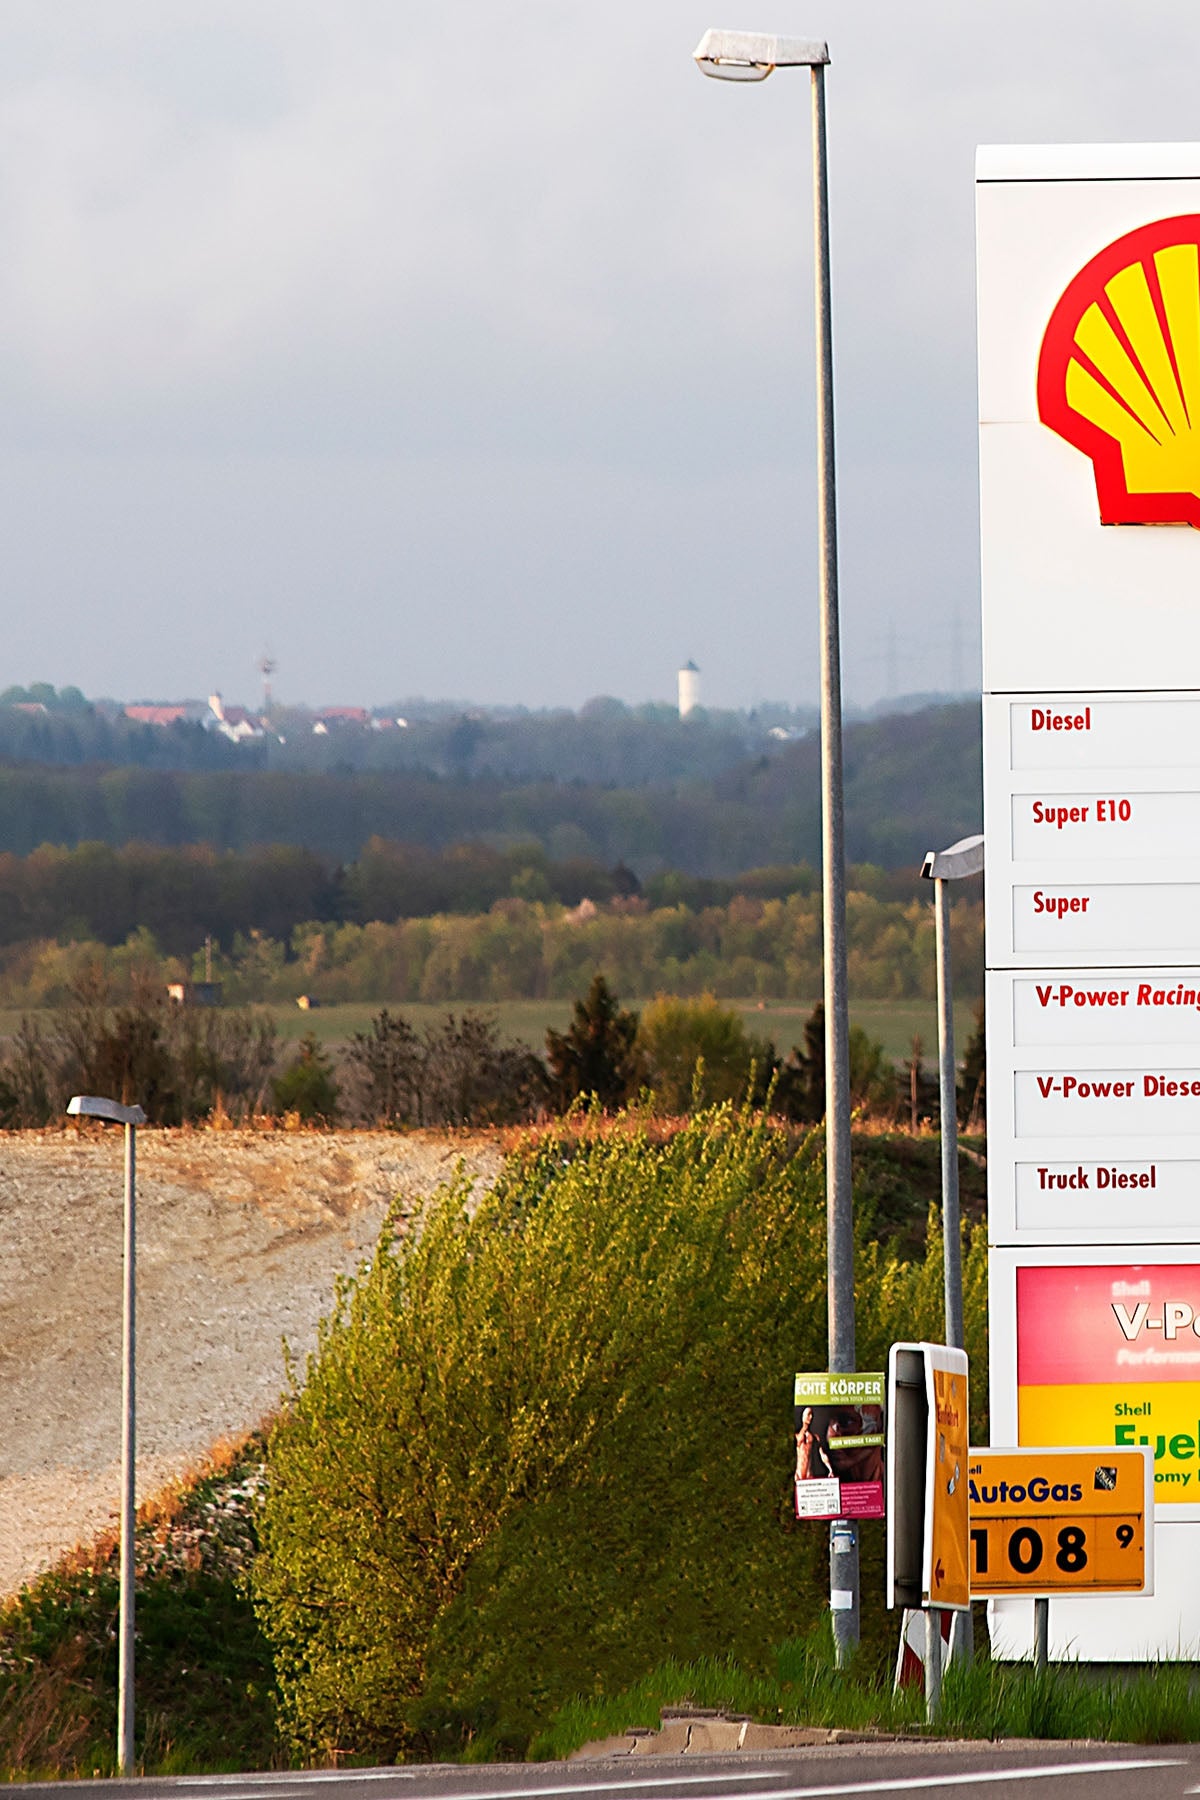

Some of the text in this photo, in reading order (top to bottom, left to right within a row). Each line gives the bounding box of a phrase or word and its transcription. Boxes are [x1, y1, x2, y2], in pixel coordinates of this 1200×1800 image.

[1031, 707, 1091, 731] Diesel
[1032, 799, 1132, 829] Super E10
[1033, 891, 1090, 919] Super
[1036, 984, 1130, 1008] V-Power
[1036, 1075, 1134, 1099] V-Power
[1038, 1166, 1156, 1190] Truck Diesel
[795, 1379, 881, 1396] ECHTE KÖRPER
[1115, 1402, 1151, 1416] Shell
[969, 1465, 982, 1474] ell
[969, 1477, 1083, 1504] AutoGas
[970, 1525, 1134, 1575] 108 9
